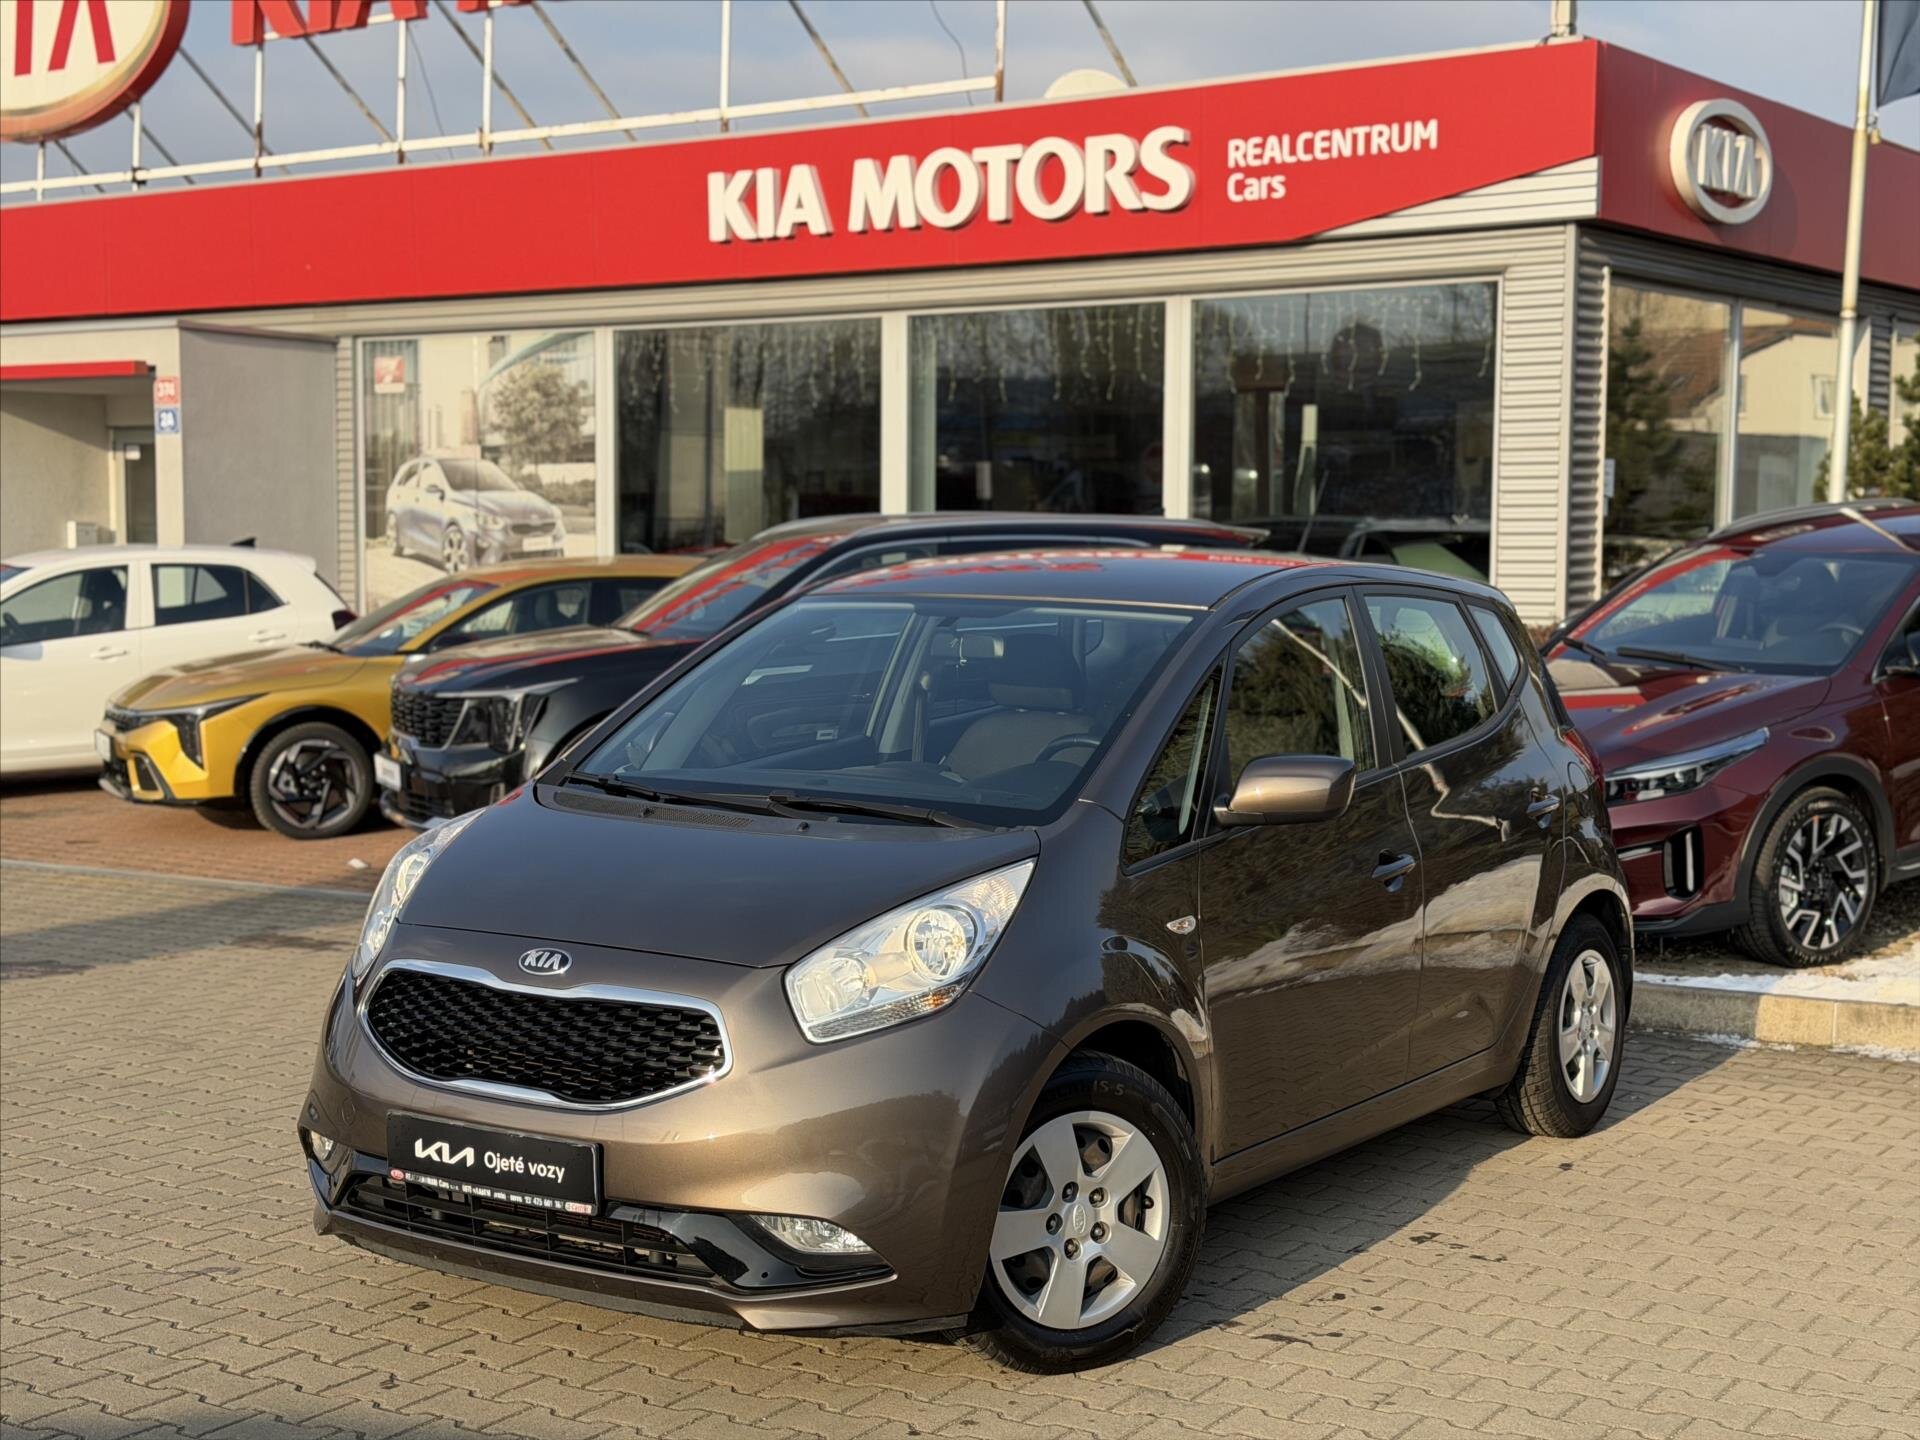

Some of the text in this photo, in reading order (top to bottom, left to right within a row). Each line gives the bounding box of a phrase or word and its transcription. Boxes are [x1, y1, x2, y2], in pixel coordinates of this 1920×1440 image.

[1227, 119, 1438, 169] REALCENTRUM
[1696, 123, 1758, 197] KIA
[707, 125, 1195, 243] KIA MOTORS
[1227, 172, 1286, 203] Cars
[523, 950, 562, 970] KIA
[414, 1138, 566, 1183] KIA Ojeté vozy
